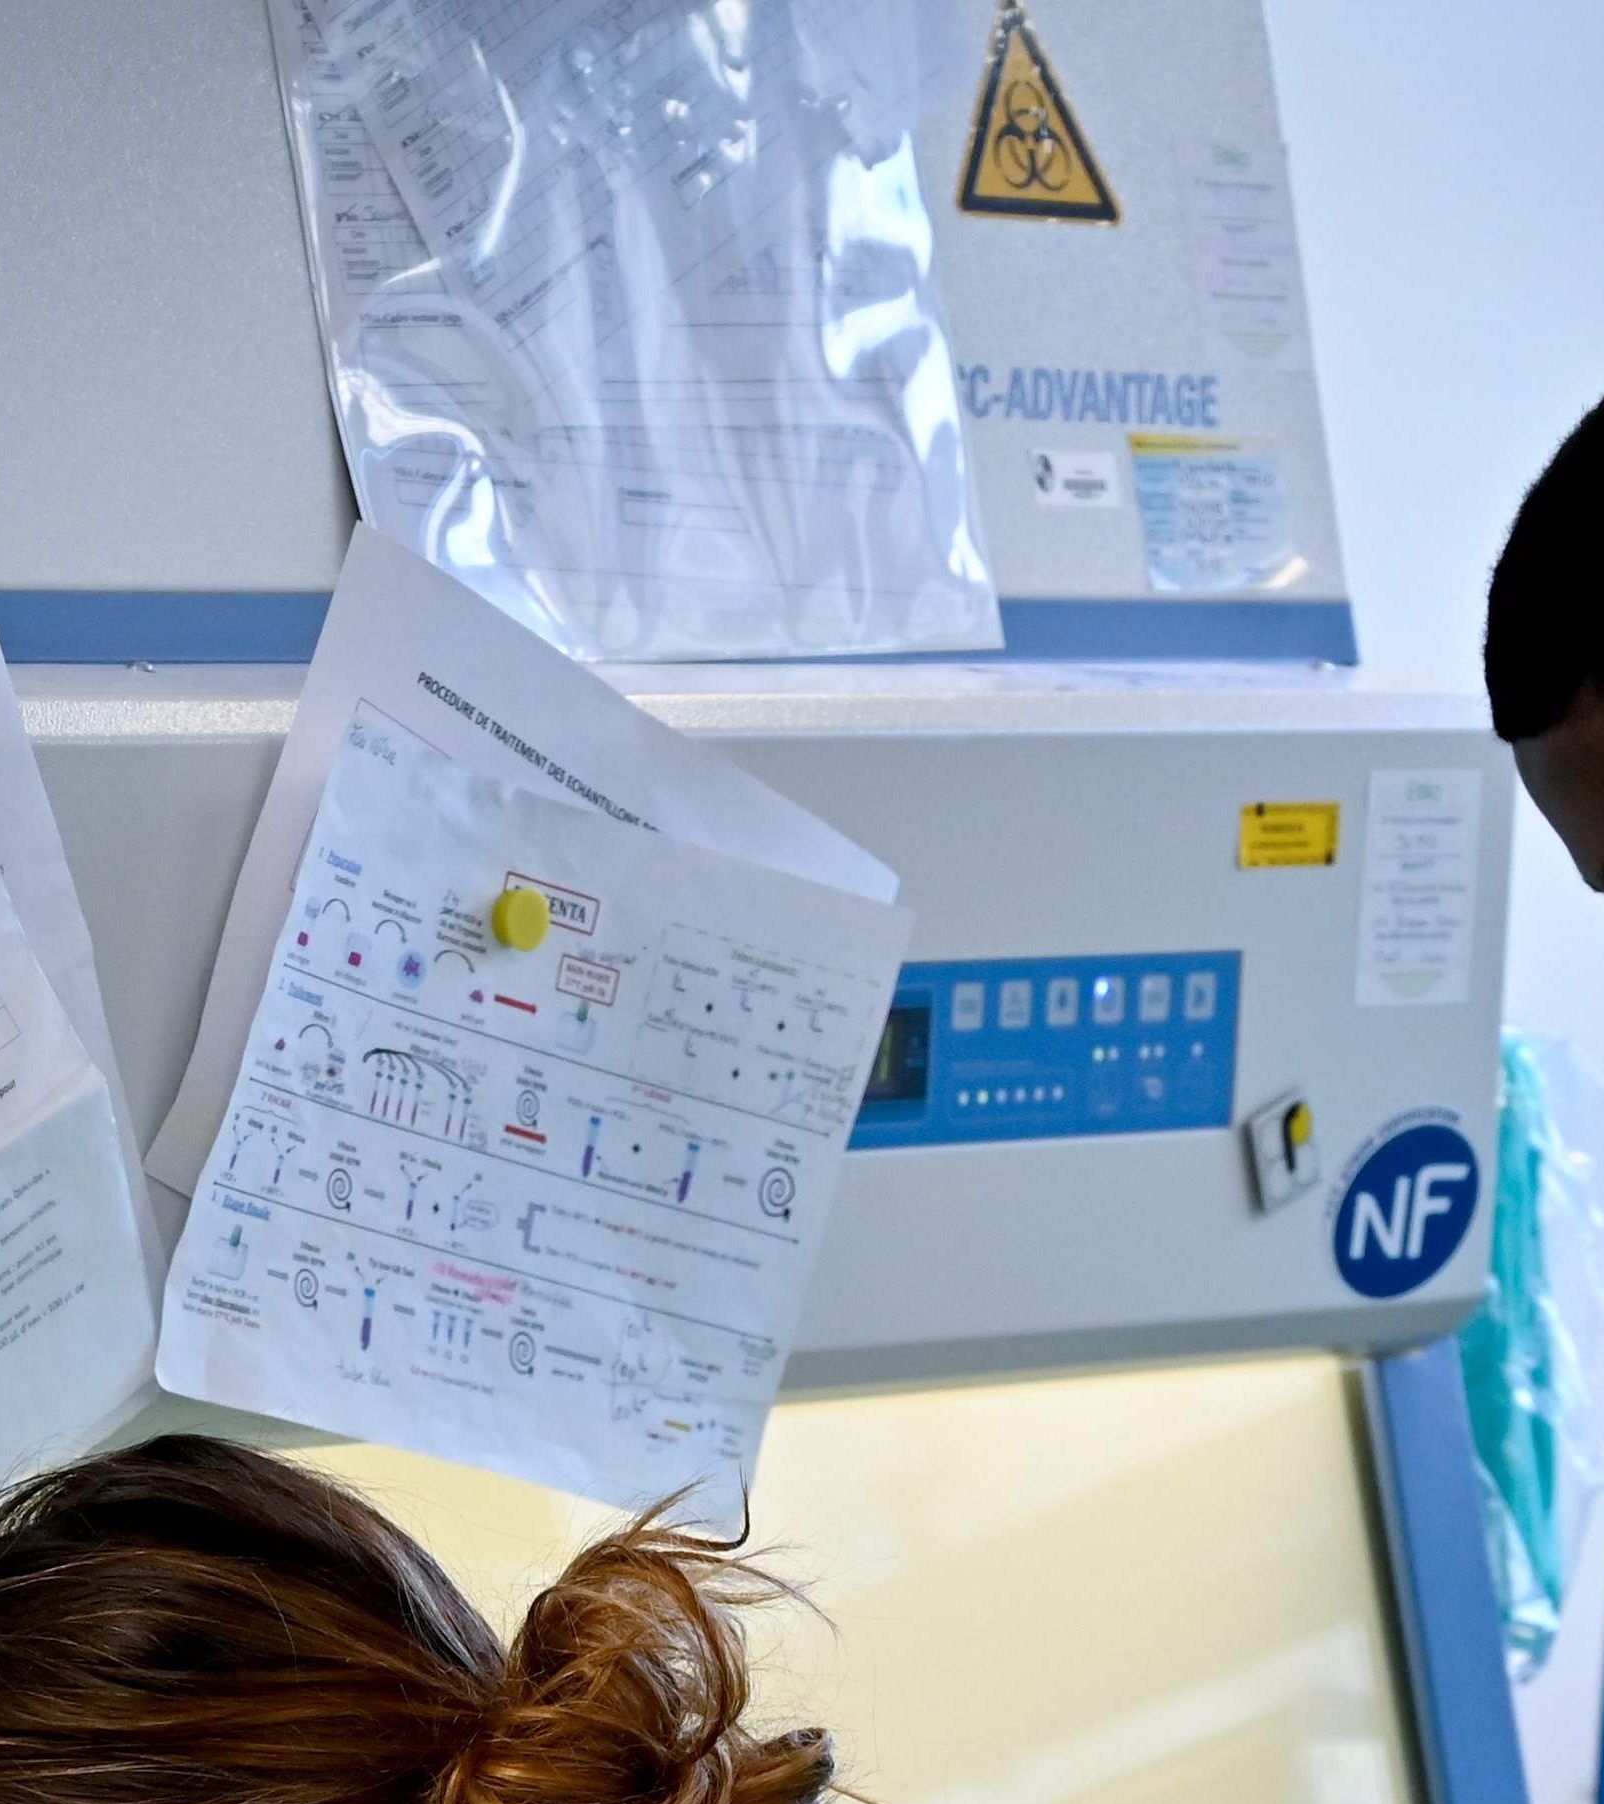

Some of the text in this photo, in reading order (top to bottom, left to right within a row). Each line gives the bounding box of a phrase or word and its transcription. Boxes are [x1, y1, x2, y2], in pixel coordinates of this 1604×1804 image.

[417, 671, 474, 718] PROCEDURE
[473, 711, 489, 730] DE
[489, 721, 546, 769] TRAITEMENT
[1349, 1163, 1470, 1260] NF
